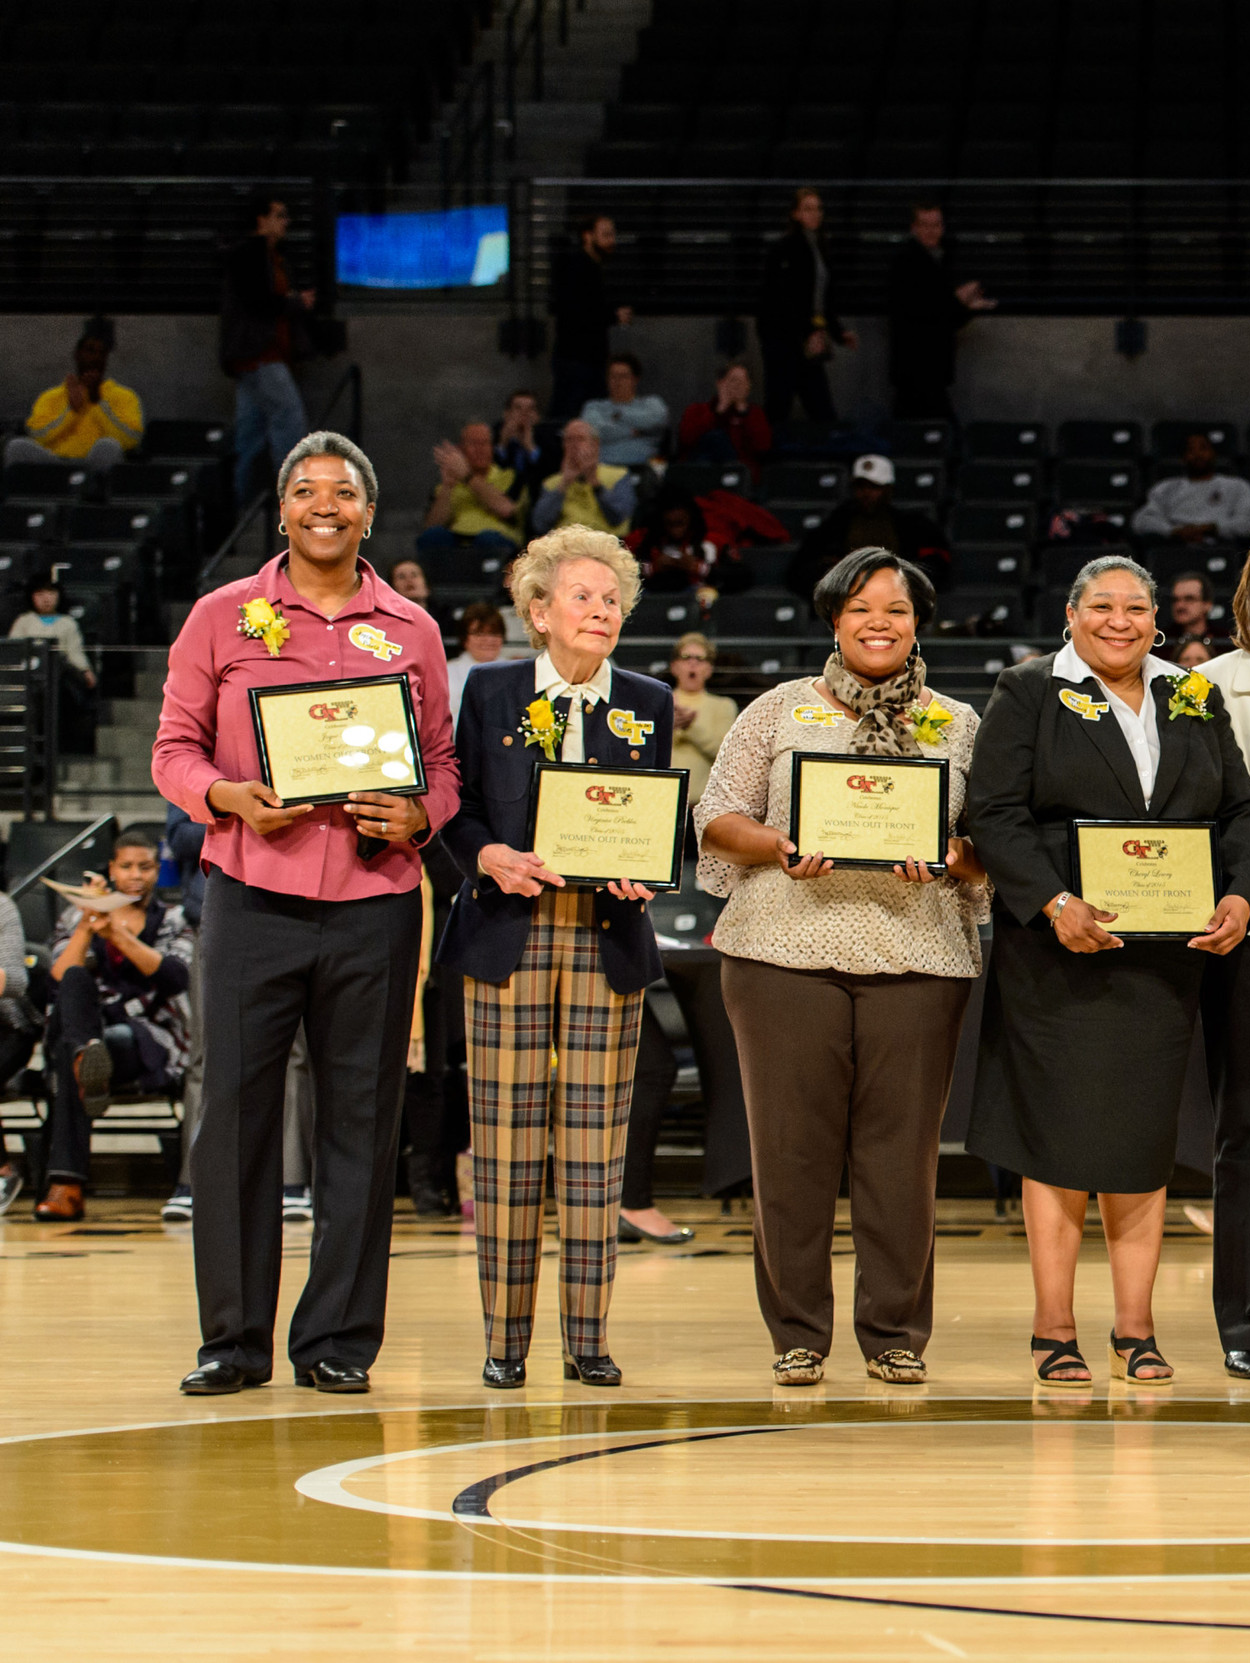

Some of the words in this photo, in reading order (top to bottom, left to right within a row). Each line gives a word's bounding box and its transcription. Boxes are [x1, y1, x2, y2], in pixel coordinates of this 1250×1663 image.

[294, 751, 332, 763] WOMEN
[824, 819, 860, 828] WOMEN
[863, 820, 882, 828] OUT
[885, 822, 916, 830] FRONT
[560, 833, 595, 842] WOMEN
[620, 837, 651, 846] FRONT
[1105, 889, 1139, 897] WOMEN
[1141, 889, 1160, 897] OUT
